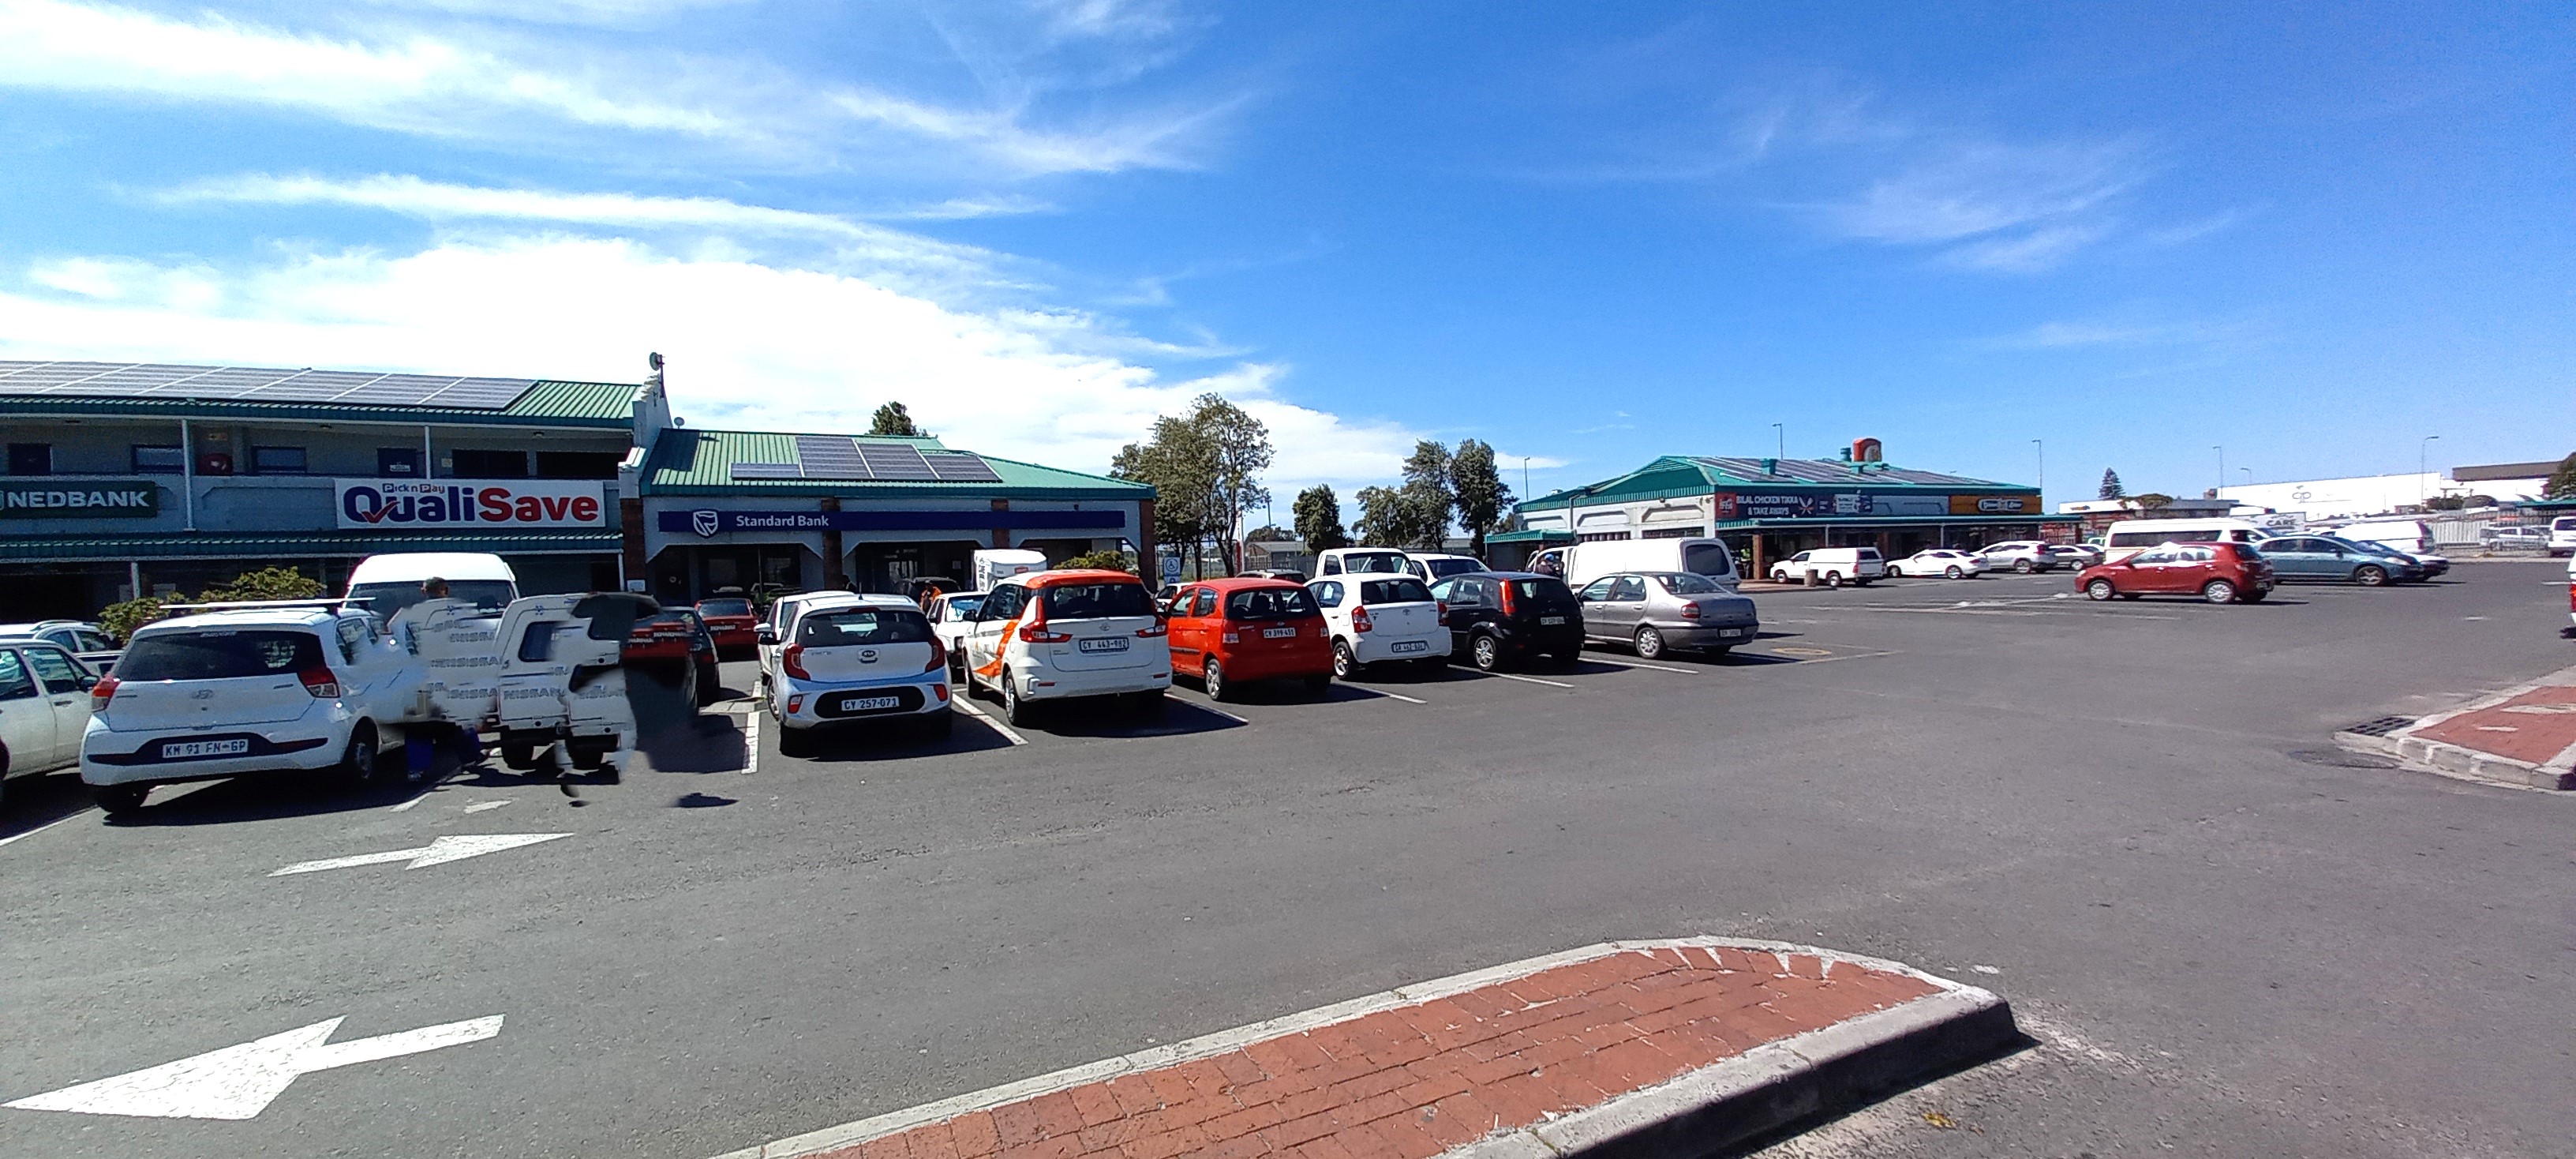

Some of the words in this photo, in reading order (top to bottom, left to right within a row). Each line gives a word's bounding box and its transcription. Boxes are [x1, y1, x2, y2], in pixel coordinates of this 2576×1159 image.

[420, 484, 445, 493] Pay
[7, 491, 149, 508] NEDBANK
[343, 486, 598, 522] QualiSave
[736, 516, 795, 527] Standard
[797, 515, 829, 527] Bank
